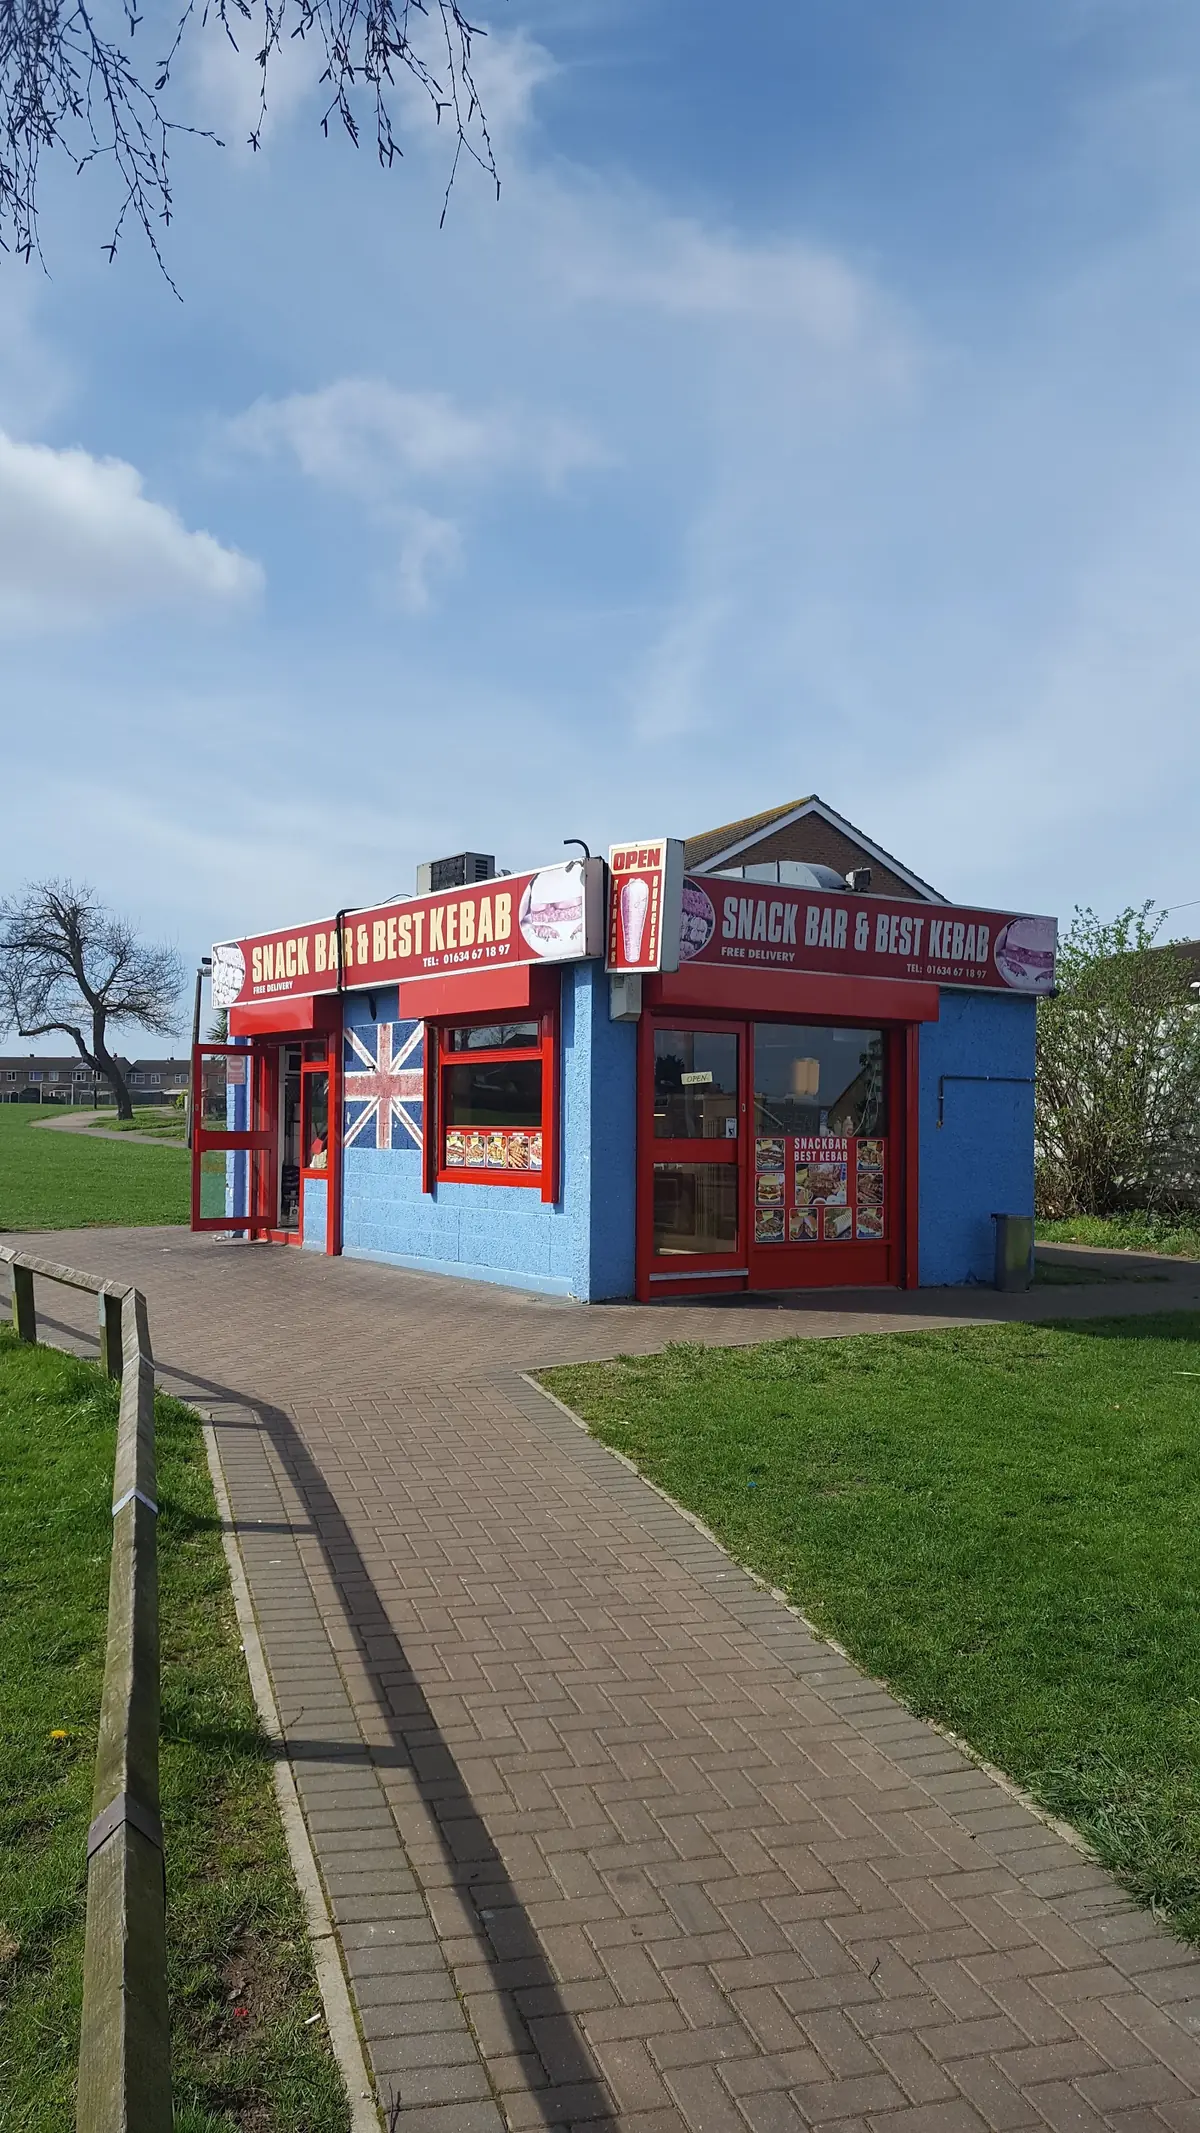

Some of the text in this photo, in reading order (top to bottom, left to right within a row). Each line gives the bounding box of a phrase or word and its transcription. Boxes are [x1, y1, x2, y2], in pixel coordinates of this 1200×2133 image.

[613, 848, 661, 871] OPEN
[611, 879, 619, 963] KEBABS
[649, 875, 659, 961] BURGERS
[252, 893, 512, 983] SNACK BAR & BEST KEBAB
[722, 896, 990, 963] SNACK BAR & BEST KEBAB
[423, 944, 510, 967] TEL: 01634 67 18 97
[721, 946, 795, 962] FREE DELIVERY
[907, 963, 987, 979] TEL: 01634 67 18 97
[253, 981, 293, 994] FREE DELIVERY
[686, 1074, 708, 1083] OPEN
[794, 1137, 848, 1150] SNACKBAR
[794, 1151, 848, 1161] BEST KEBAB
